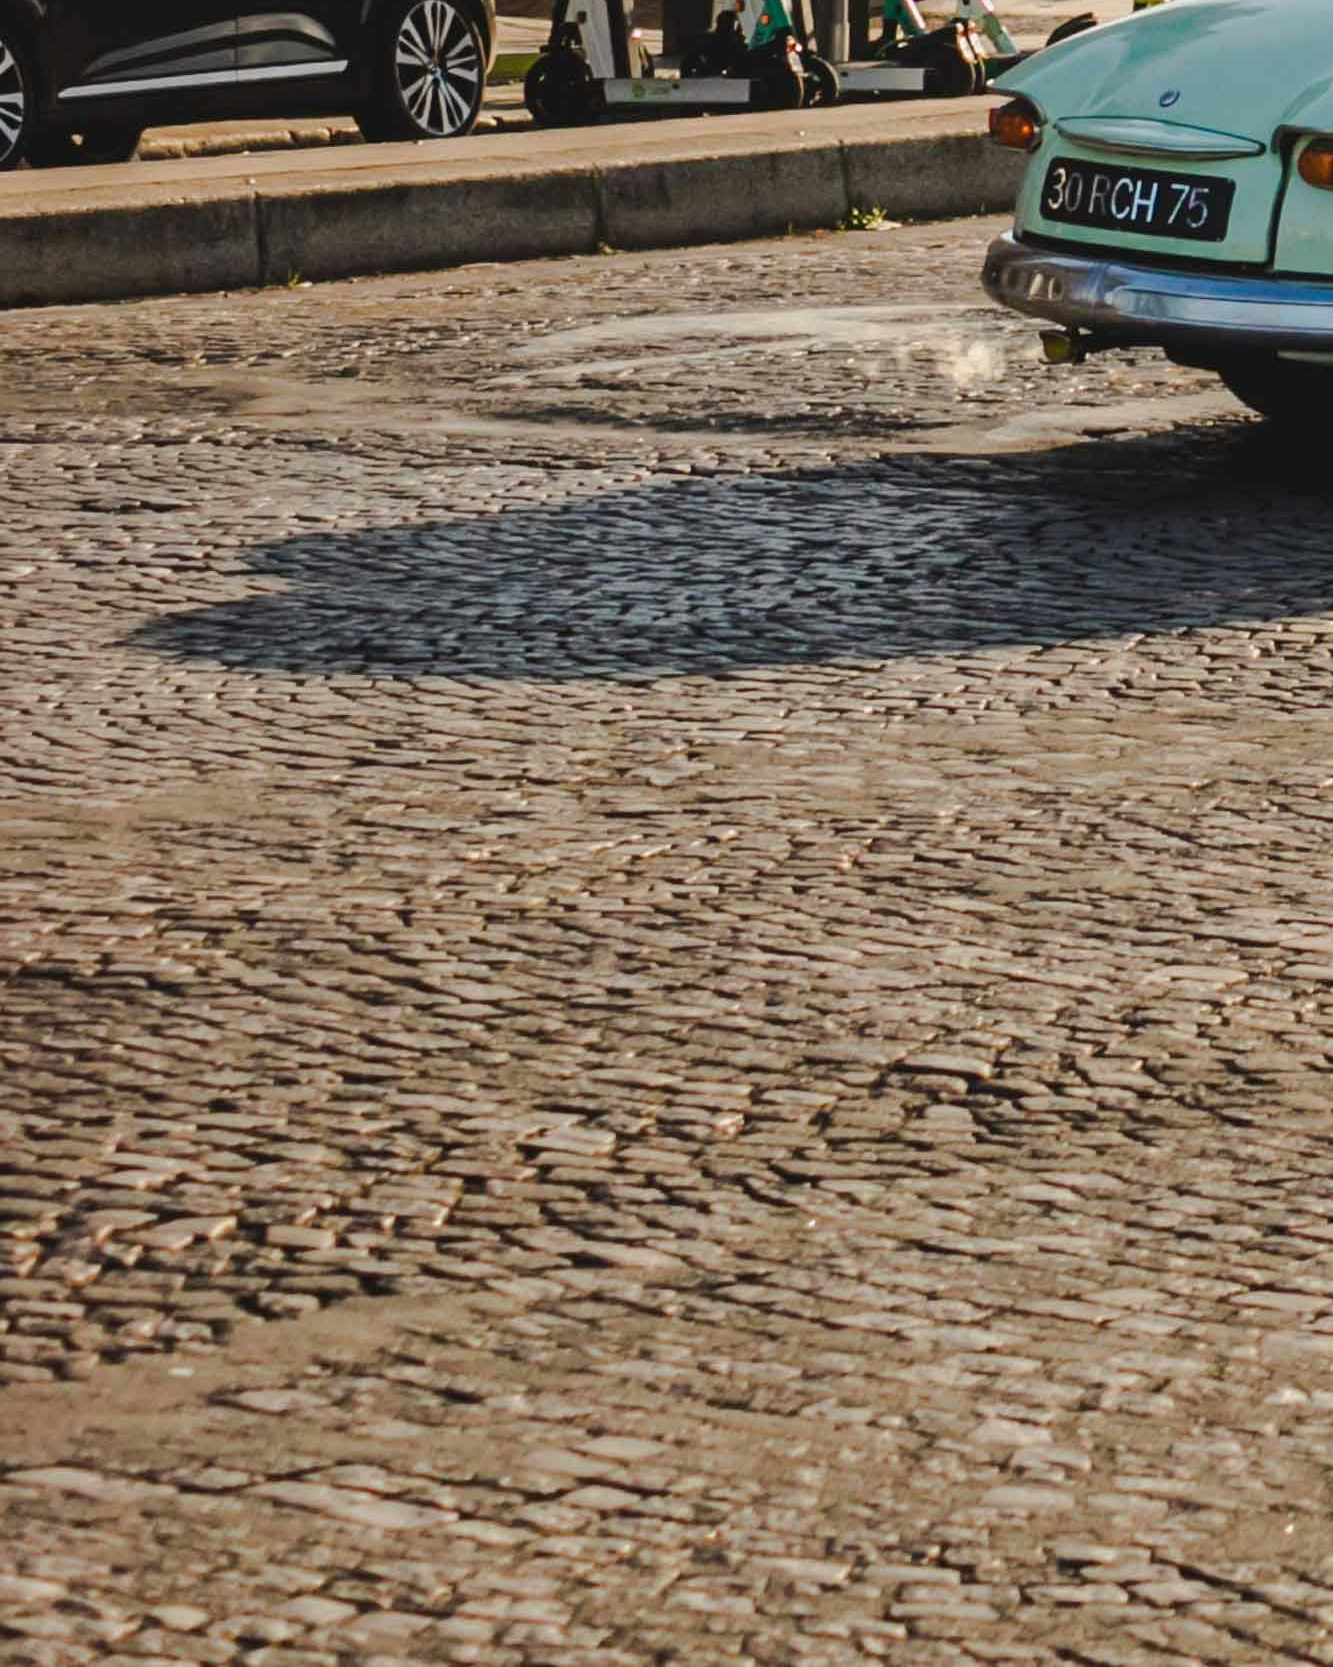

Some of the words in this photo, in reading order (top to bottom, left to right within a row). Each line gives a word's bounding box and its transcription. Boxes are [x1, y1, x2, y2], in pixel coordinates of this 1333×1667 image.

[1047, 167, 1083, 212] 30
[1087, 174, 1158, 223] RCH
[1167, 183, 1209, 228] 75
